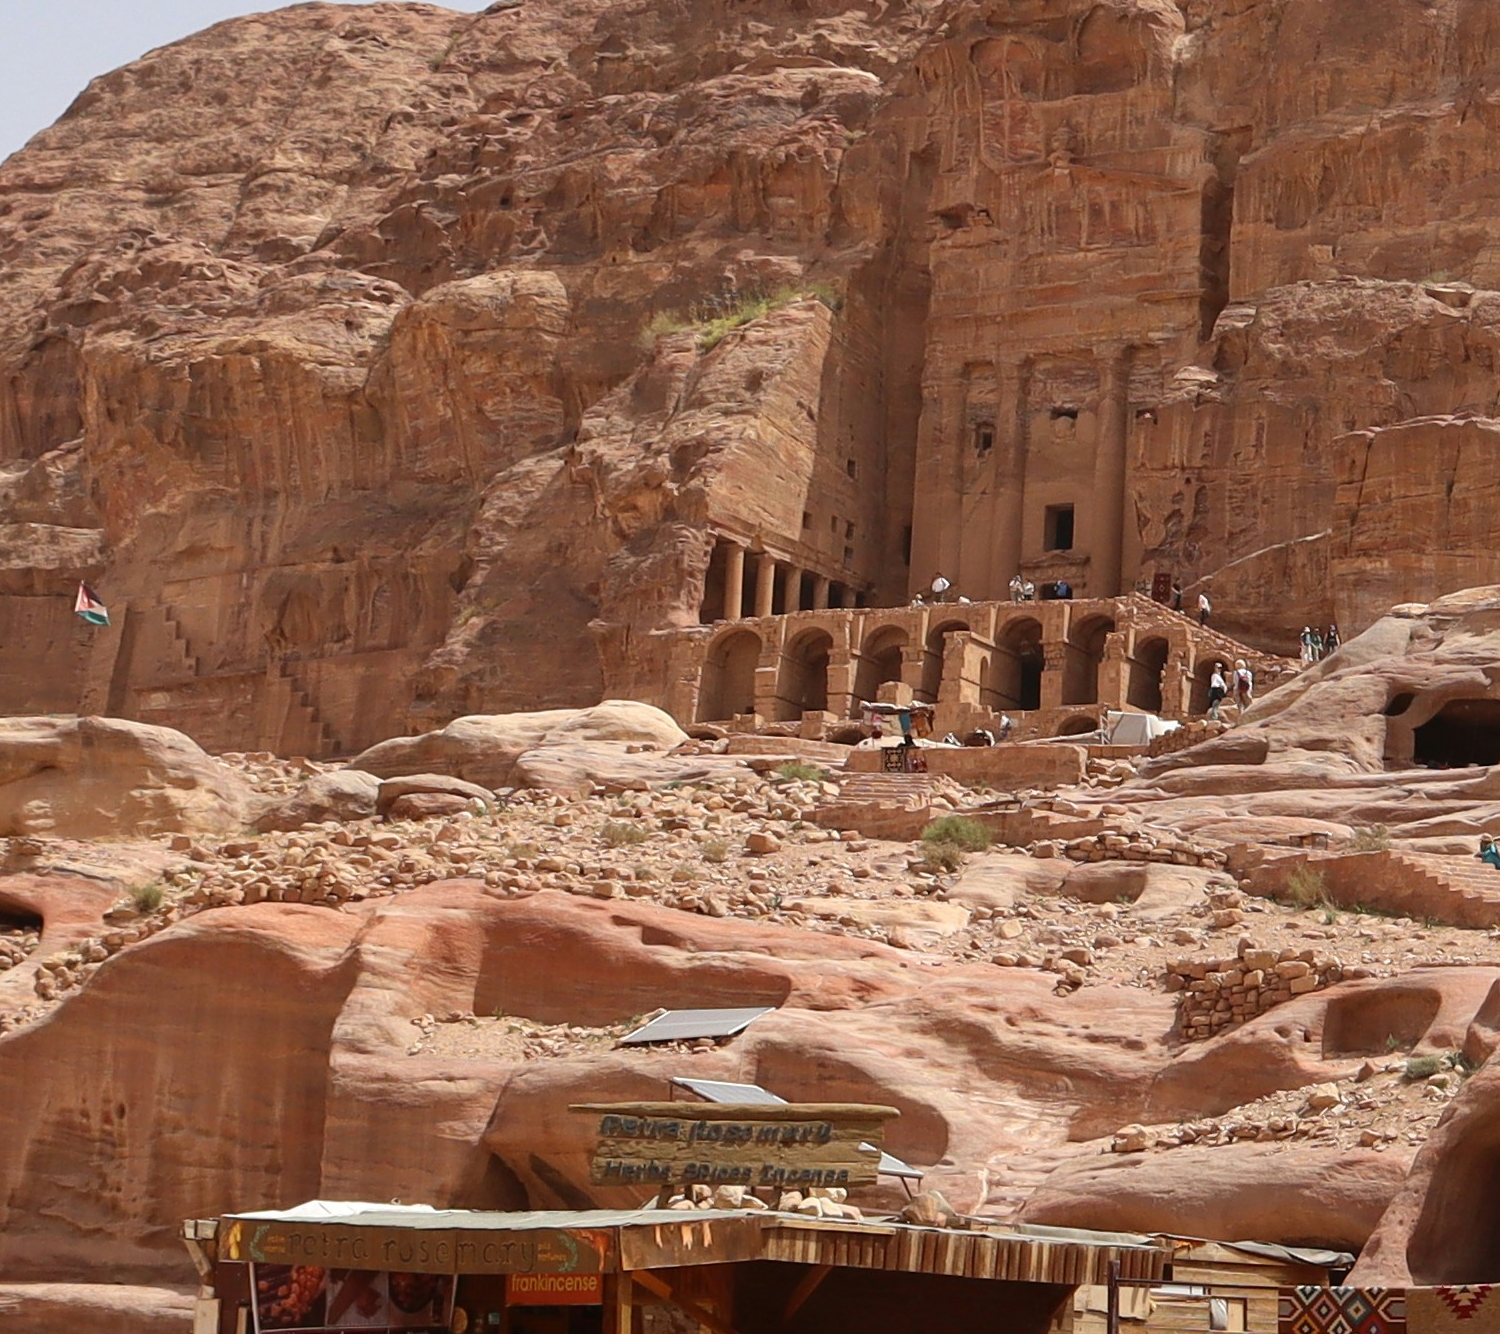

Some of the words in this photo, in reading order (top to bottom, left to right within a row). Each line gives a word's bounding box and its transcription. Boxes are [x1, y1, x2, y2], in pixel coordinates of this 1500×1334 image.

[601, 1115, 680, 1138] Petra
[604, 1159, 671, 1181] Herbs
[760, 1164, 850, 1182] Incense
[512, 1275, 597, 1292] frankincense
